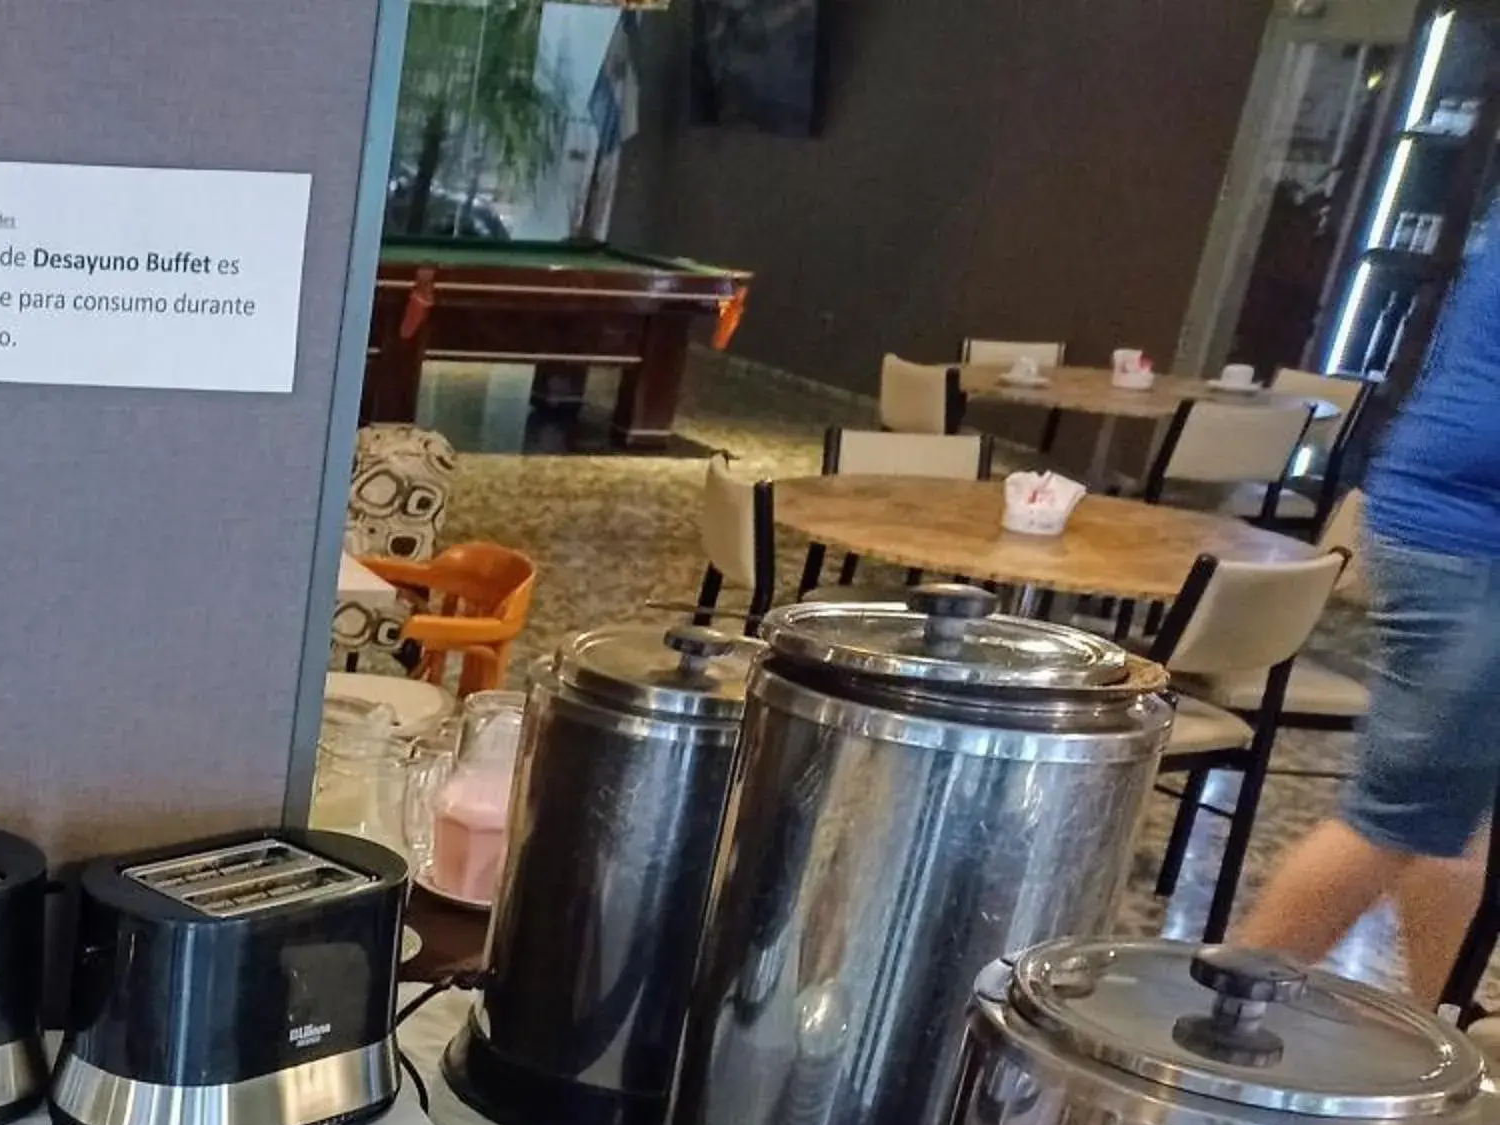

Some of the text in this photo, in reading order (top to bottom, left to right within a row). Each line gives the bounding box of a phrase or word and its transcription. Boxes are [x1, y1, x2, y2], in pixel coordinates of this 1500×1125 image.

[0, 245, 26, 267] de
[33, 247, 140, 274] Desayuno
[146, 251, 211, 274] Buffet
[217, 257, 240, 275] es
[19, 291, 66, 313] para
[73, 293, 167, 314] consumo
[174, 293, 256, 316] durante
